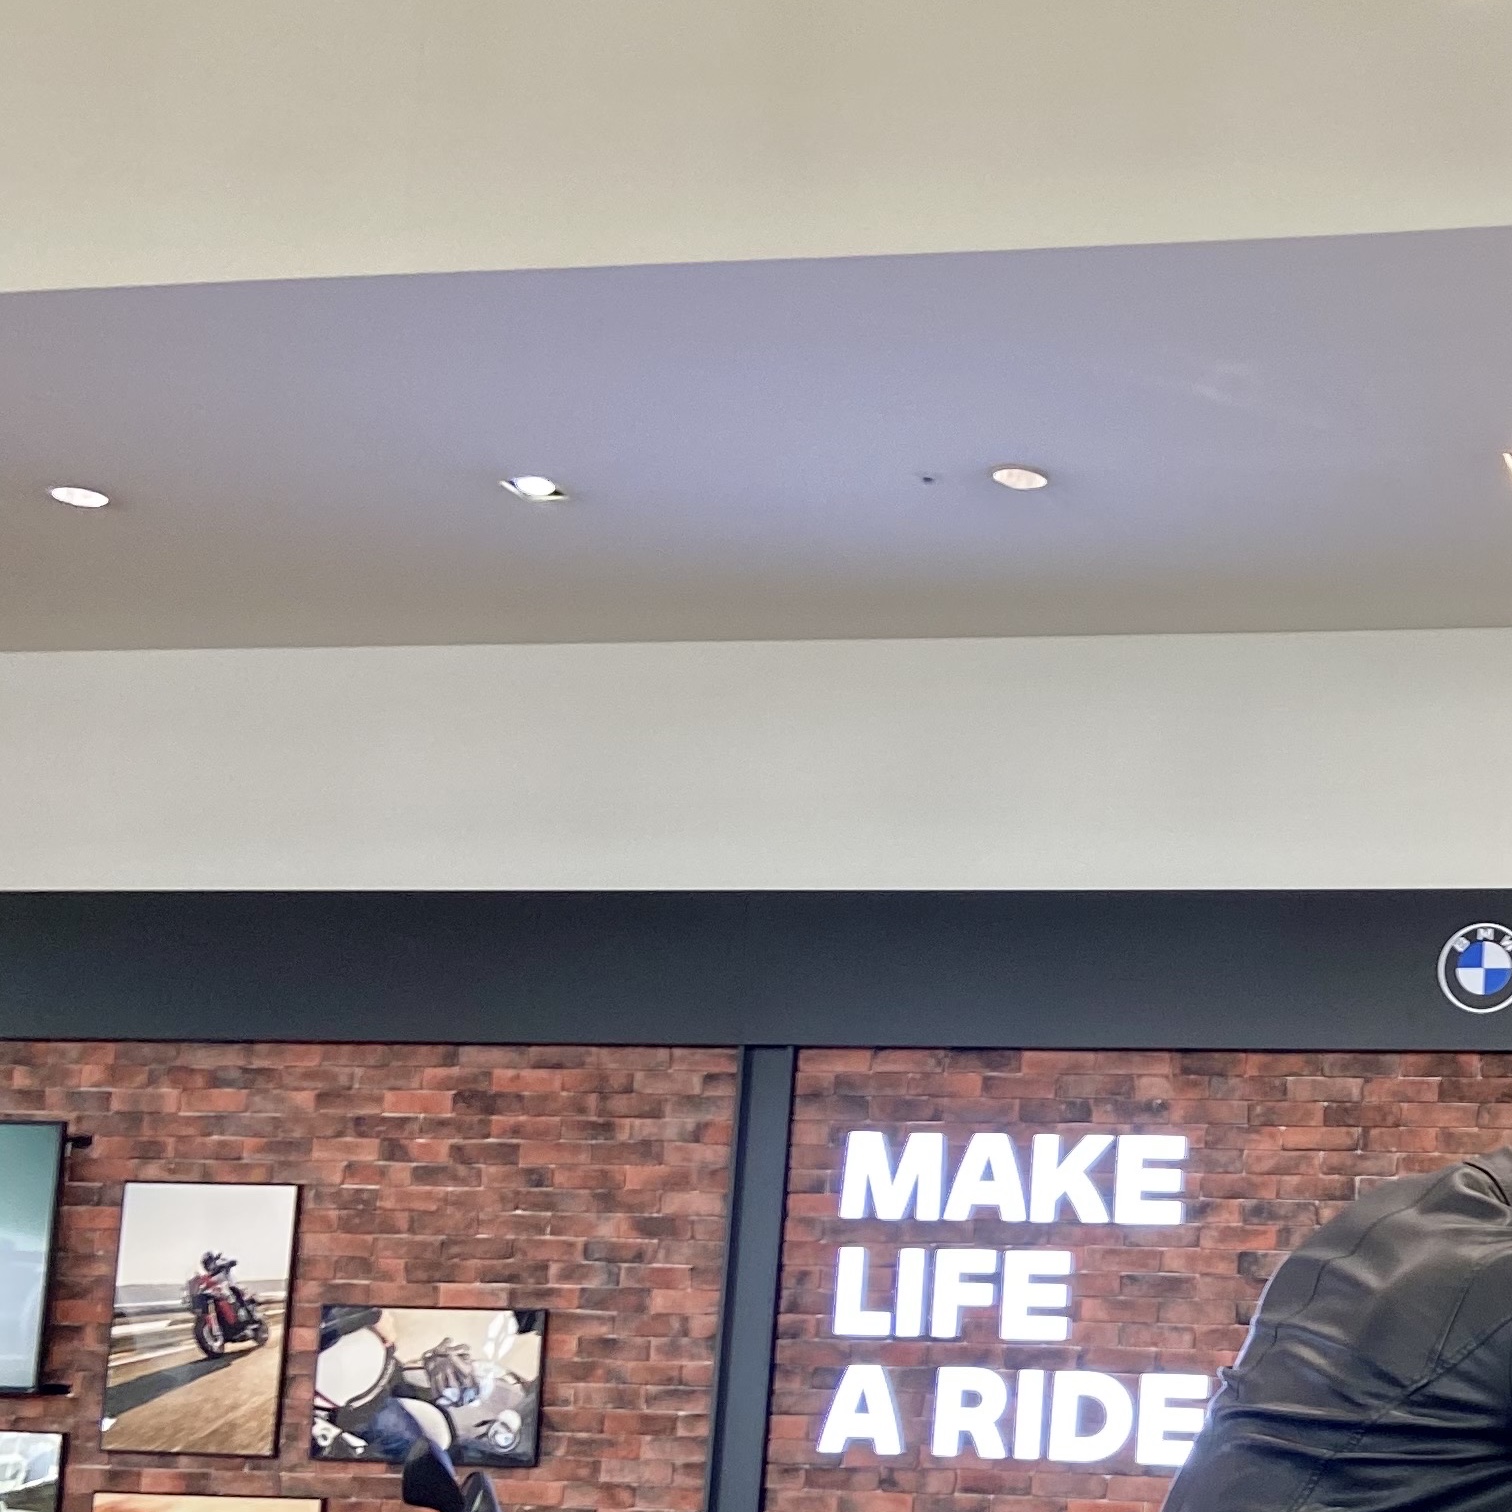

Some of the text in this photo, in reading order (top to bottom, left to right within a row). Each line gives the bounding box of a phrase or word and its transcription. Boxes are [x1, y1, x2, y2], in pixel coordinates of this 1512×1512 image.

[838, 1130, 1190, 1226] MAKE
[832, 1246, 1074, 1341] LIFE
[816, 1364, 1211, 1467] A RIDE
